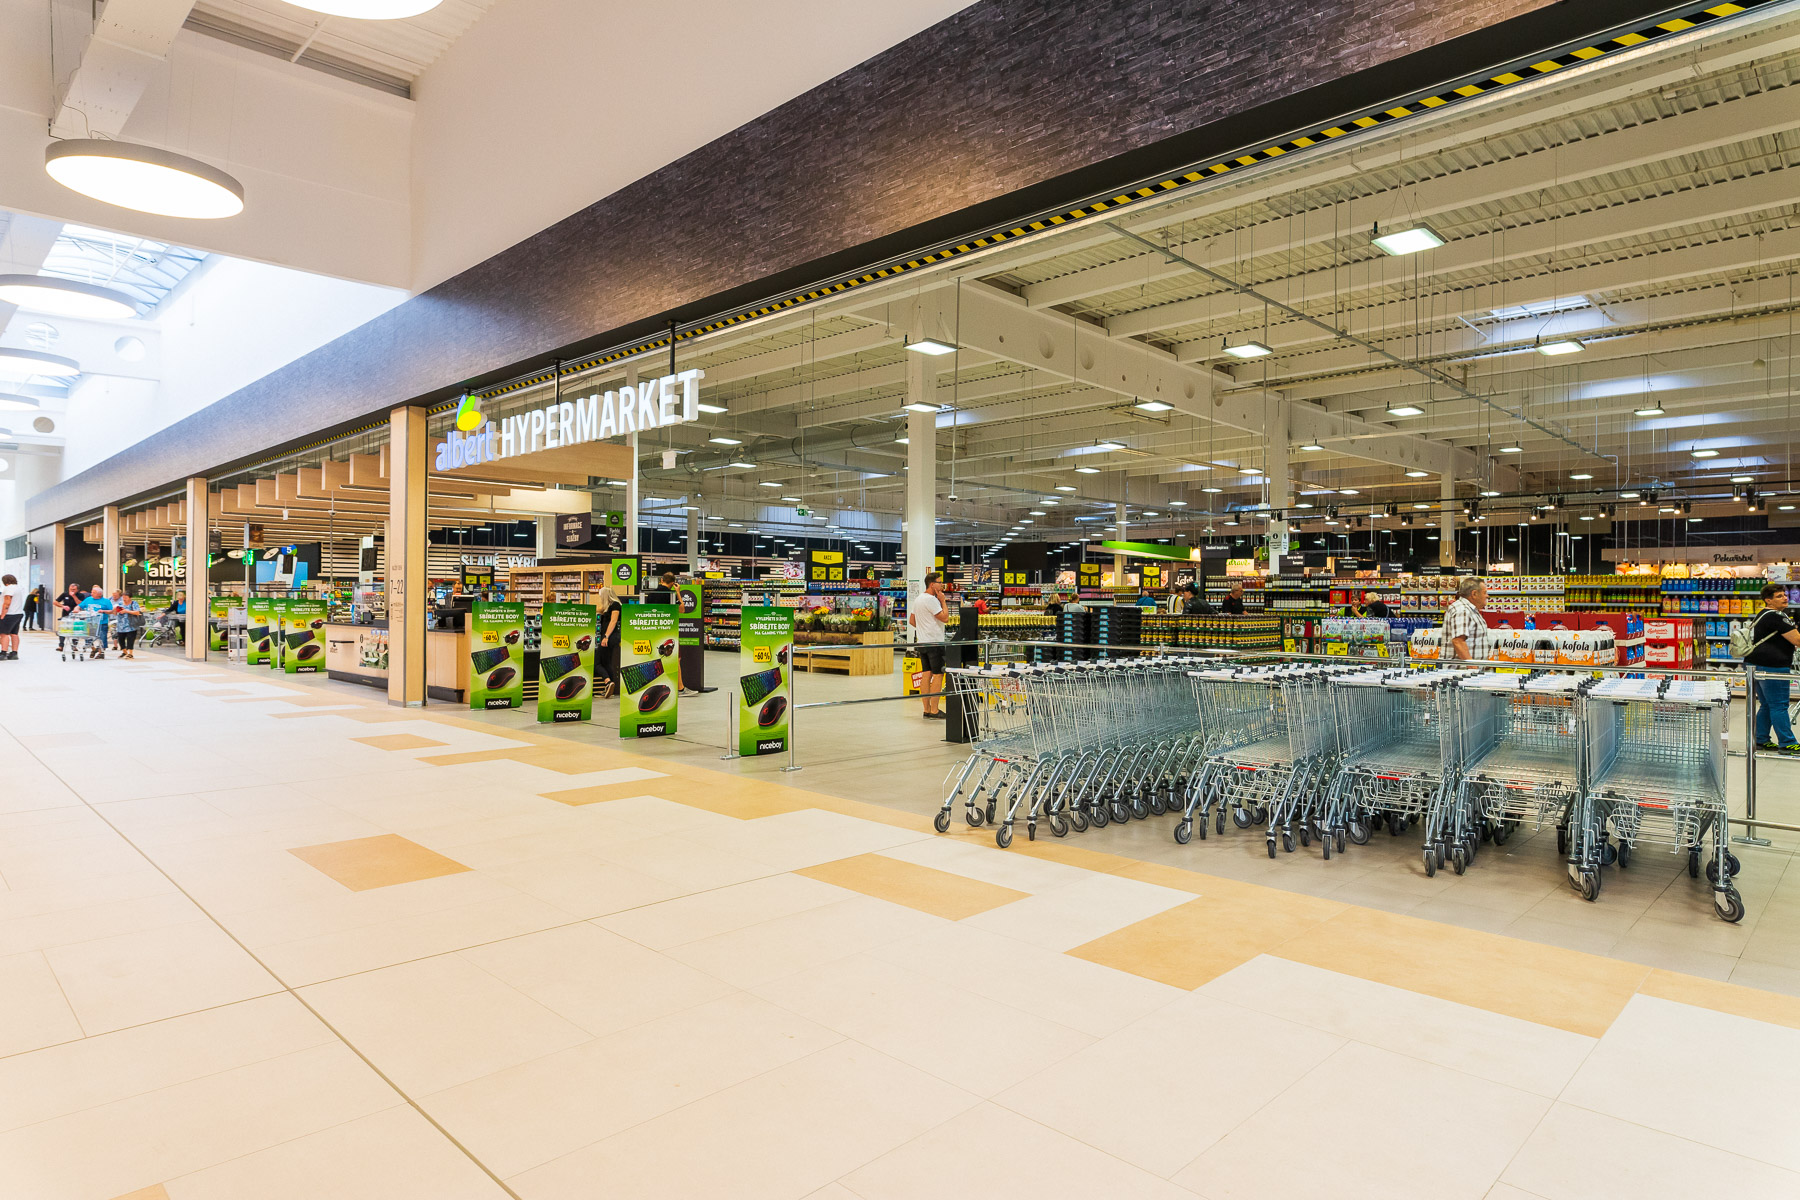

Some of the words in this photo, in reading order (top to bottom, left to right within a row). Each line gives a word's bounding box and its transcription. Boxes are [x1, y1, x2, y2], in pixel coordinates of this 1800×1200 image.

[501, 369, 704, 458] HYPERMARKET
[435, 422, 499, 471] albert
[461, 553, 500, 570] SLANÉ
[1713, 554, 1753, 562] Pekařství
[149, 564, 186, 577] albe
[750, 622, 777, 630] SBÍREJTE
[1414, 637, 1434, 648] kofola
[1503, 639, 1528, 650] kofola
[1562, 641, 1589, 652] kofola
[755, 652, 763, 660] -60
[764, 652, 770, 660] %
[640, 725, 664, 734] niceboy
[760, 741, 782, 750] niceboy
